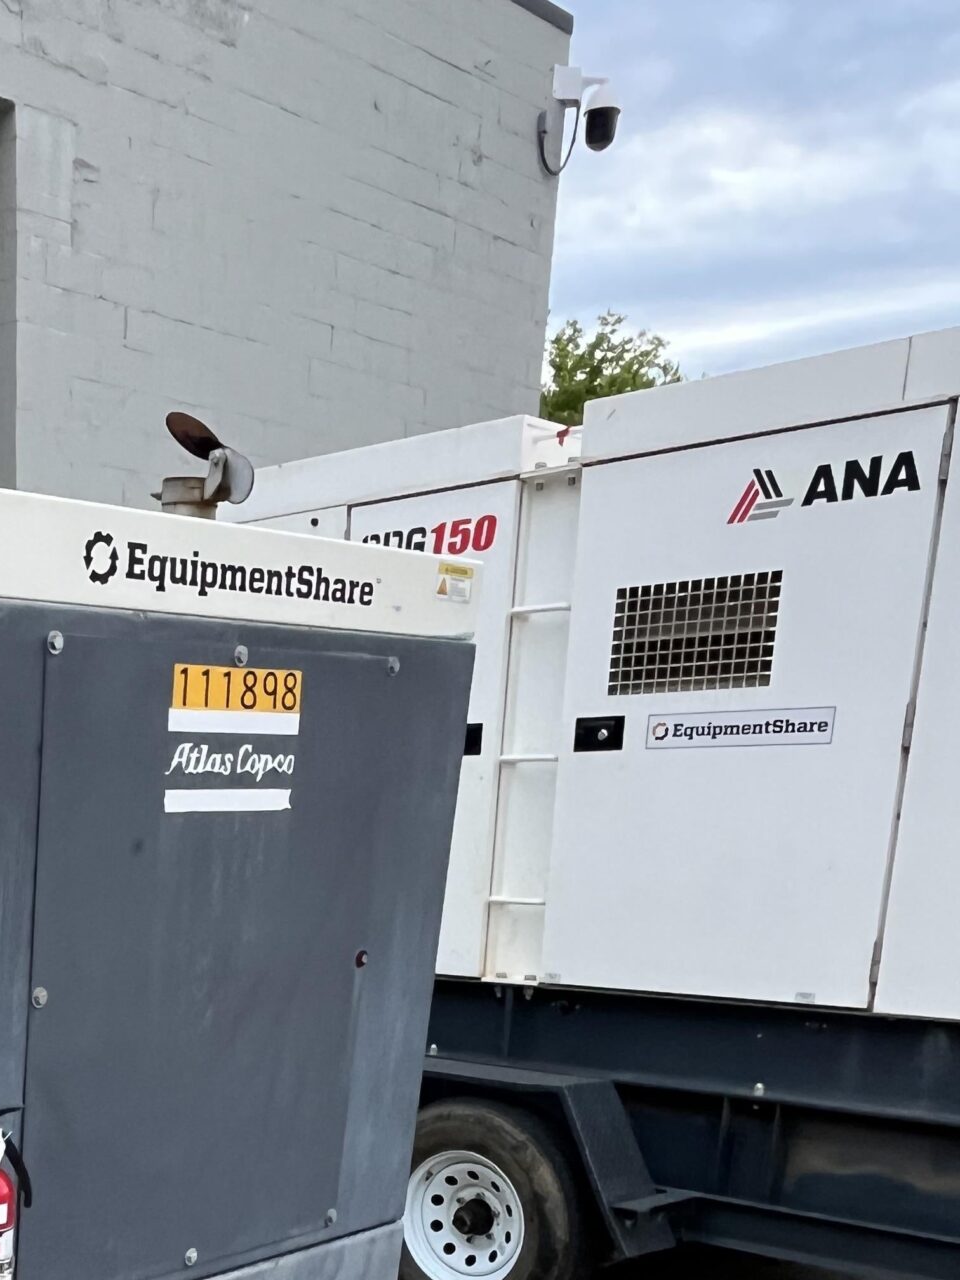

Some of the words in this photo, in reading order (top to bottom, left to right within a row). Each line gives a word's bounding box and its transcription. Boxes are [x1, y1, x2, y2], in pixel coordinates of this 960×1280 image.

[801, 451, 921, 507] ANA
[362, 514, 497, 555] G150
[125, 541, 374, 606] EquipmentShare
[180, 667, 298, 711] 111898
[672, 719, 829, 740] EquipmentShare
[164, 742, 234, 776] Atlas
[236, 744, 295, 782] Copco
